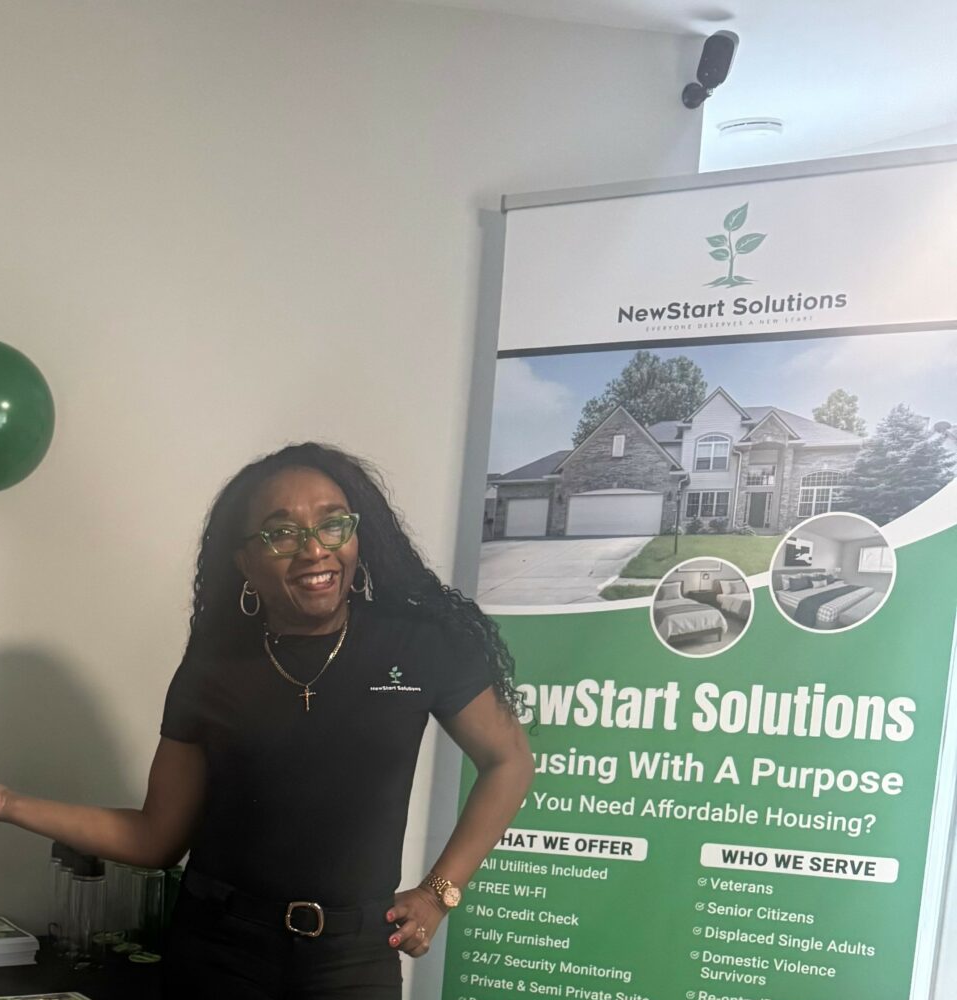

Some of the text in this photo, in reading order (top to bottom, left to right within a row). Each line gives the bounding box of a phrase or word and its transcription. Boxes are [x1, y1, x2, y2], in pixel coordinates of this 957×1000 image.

[618, 292, 847, 323] NewStart Solutions
[646, 324, 692, 332] EVERYONE
[692, 681, 917, 742] Solutions
[629, 750, 705, 783] With
[714, 756, 740, 785] A
[751, 757, 904, 798] Purpose
[533, 792, 572, 812] You
[579, 794, 635, 816] Need
[640, 797, 758, 825] Affordable
[765, 806, 876, 838] Housing?
[543, 836, 570, 851] WE
[575, 838, 633, 856] OFFER
[480, 858, 608, 880] All Utilities Included
[722, 848, 876, 877] WHO WE SERVE
[478, 882, 546, 898] FREE WI-FI
[710, 878, 774, 894] Veterans
[476, 904, 579, 926] No Credit Check
[707, 902, 814, 924] Senior Citizens
[474, 928, 570, 949] Fully Furnished
[704, 926, 876, 956] Displaced Single Adults
[472, 951, 632, 983] 24/7 Security Monitoring
[702, 950, 836, 978] Domestic Violence
[470, 974, 514, 991] Private
[516, 980, 526, 992] &
[529, 981, 562, 997] Semi
[700, 966, 766, 986] Survivors
